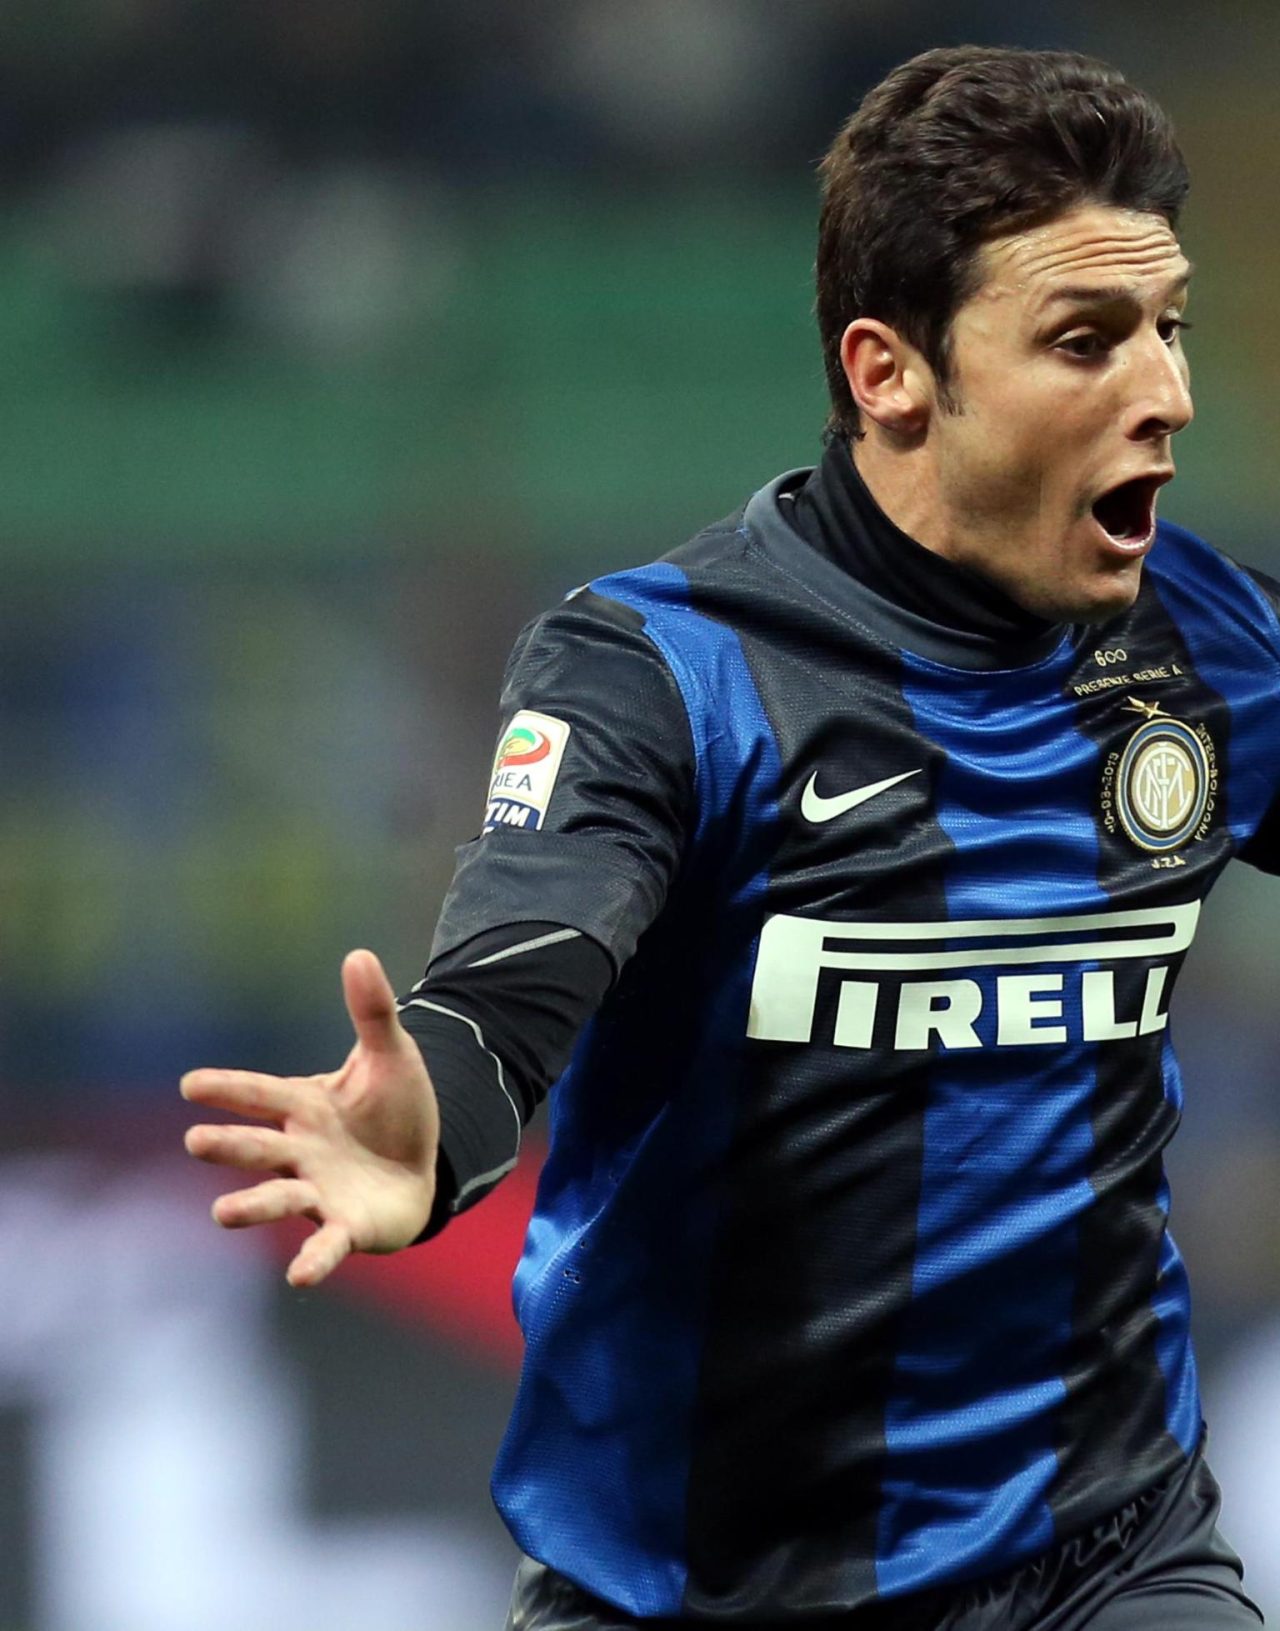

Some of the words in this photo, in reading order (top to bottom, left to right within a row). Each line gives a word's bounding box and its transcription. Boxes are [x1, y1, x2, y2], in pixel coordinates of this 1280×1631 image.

[1094, 648, 1127, 667] 600
[1074, 675, 1131, 696] PRESENZE
[1133, 667, 1170, 682] SERIE
[1172, 664, 1183, 676] A
